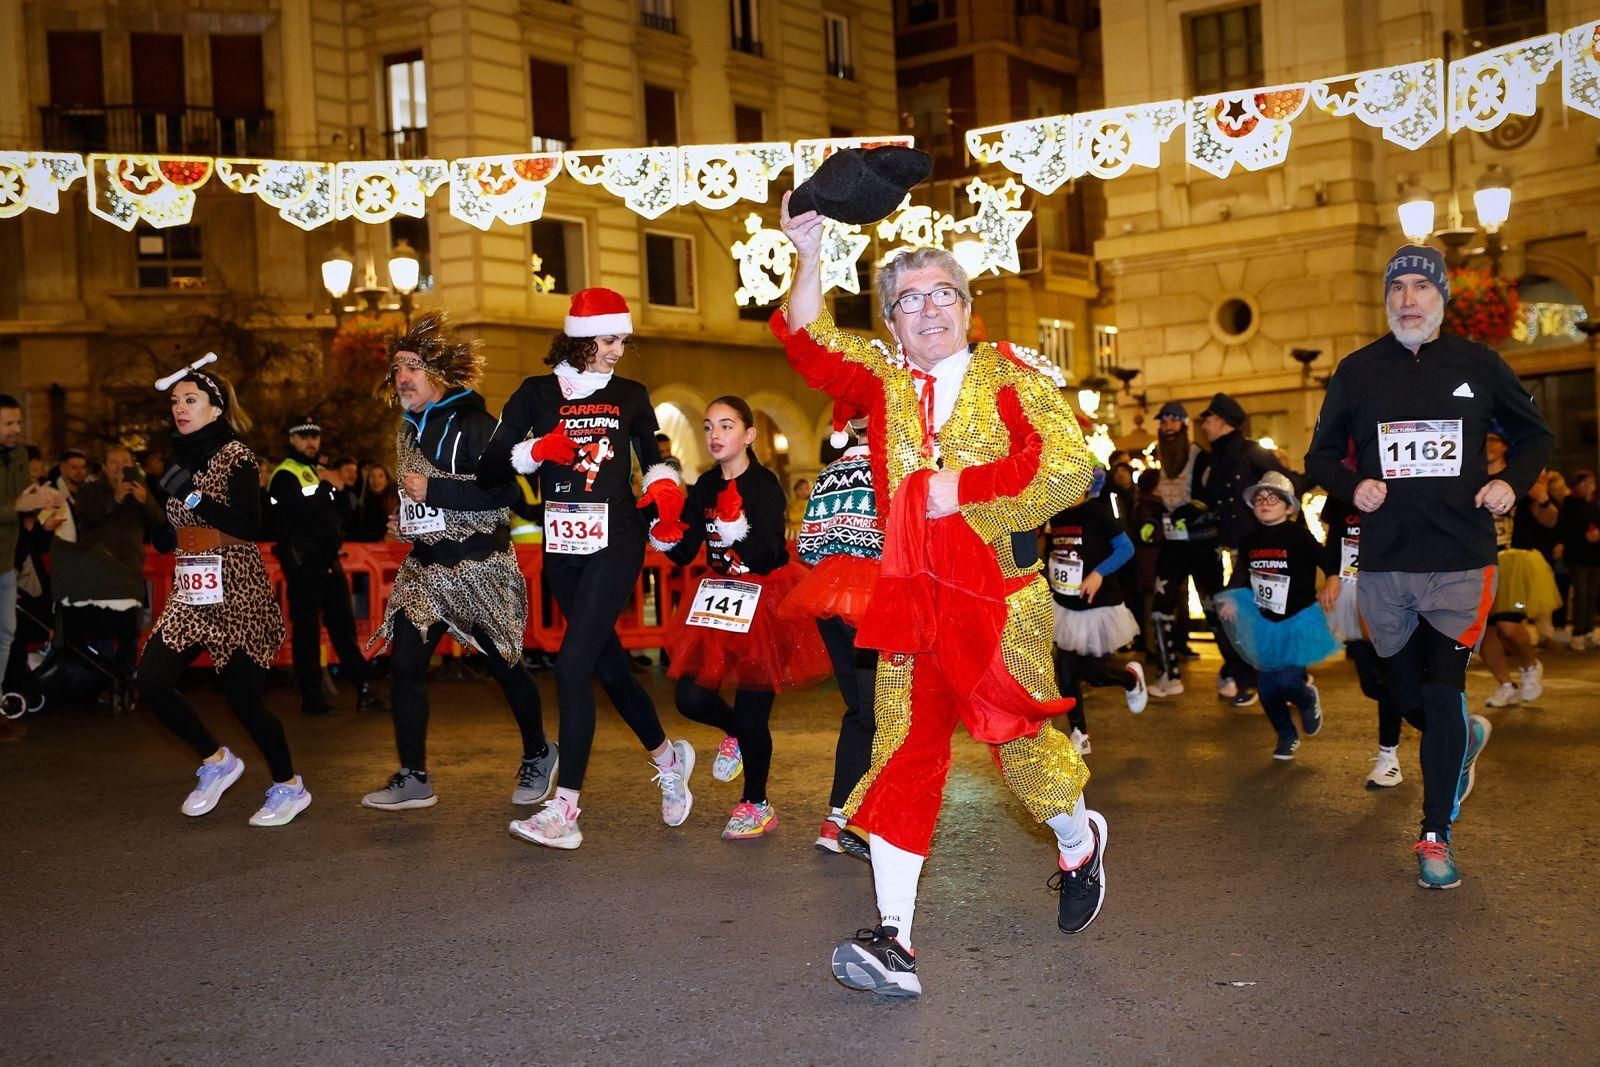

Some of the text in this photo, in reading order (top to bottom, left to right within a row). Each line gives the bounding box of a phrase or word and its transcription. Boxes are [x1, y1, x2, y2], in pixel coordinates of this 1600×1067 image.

[560, 403, 620, 417] CARRERA
[570, 428, 608, 436] DISFRACES
[571, 436, 593, 444] NADA
[1387, 440, 1457, 462] 1162
[550, 519, 604, 540] 1334
[1250, 560, 1288, 569] NOCTURNA
[178, 573, 218, 590] 1883
[1054, 567, 1068, 583] 88
[1259, 584, 1273, 600] 89
[704, 595, 743, 617] 141
